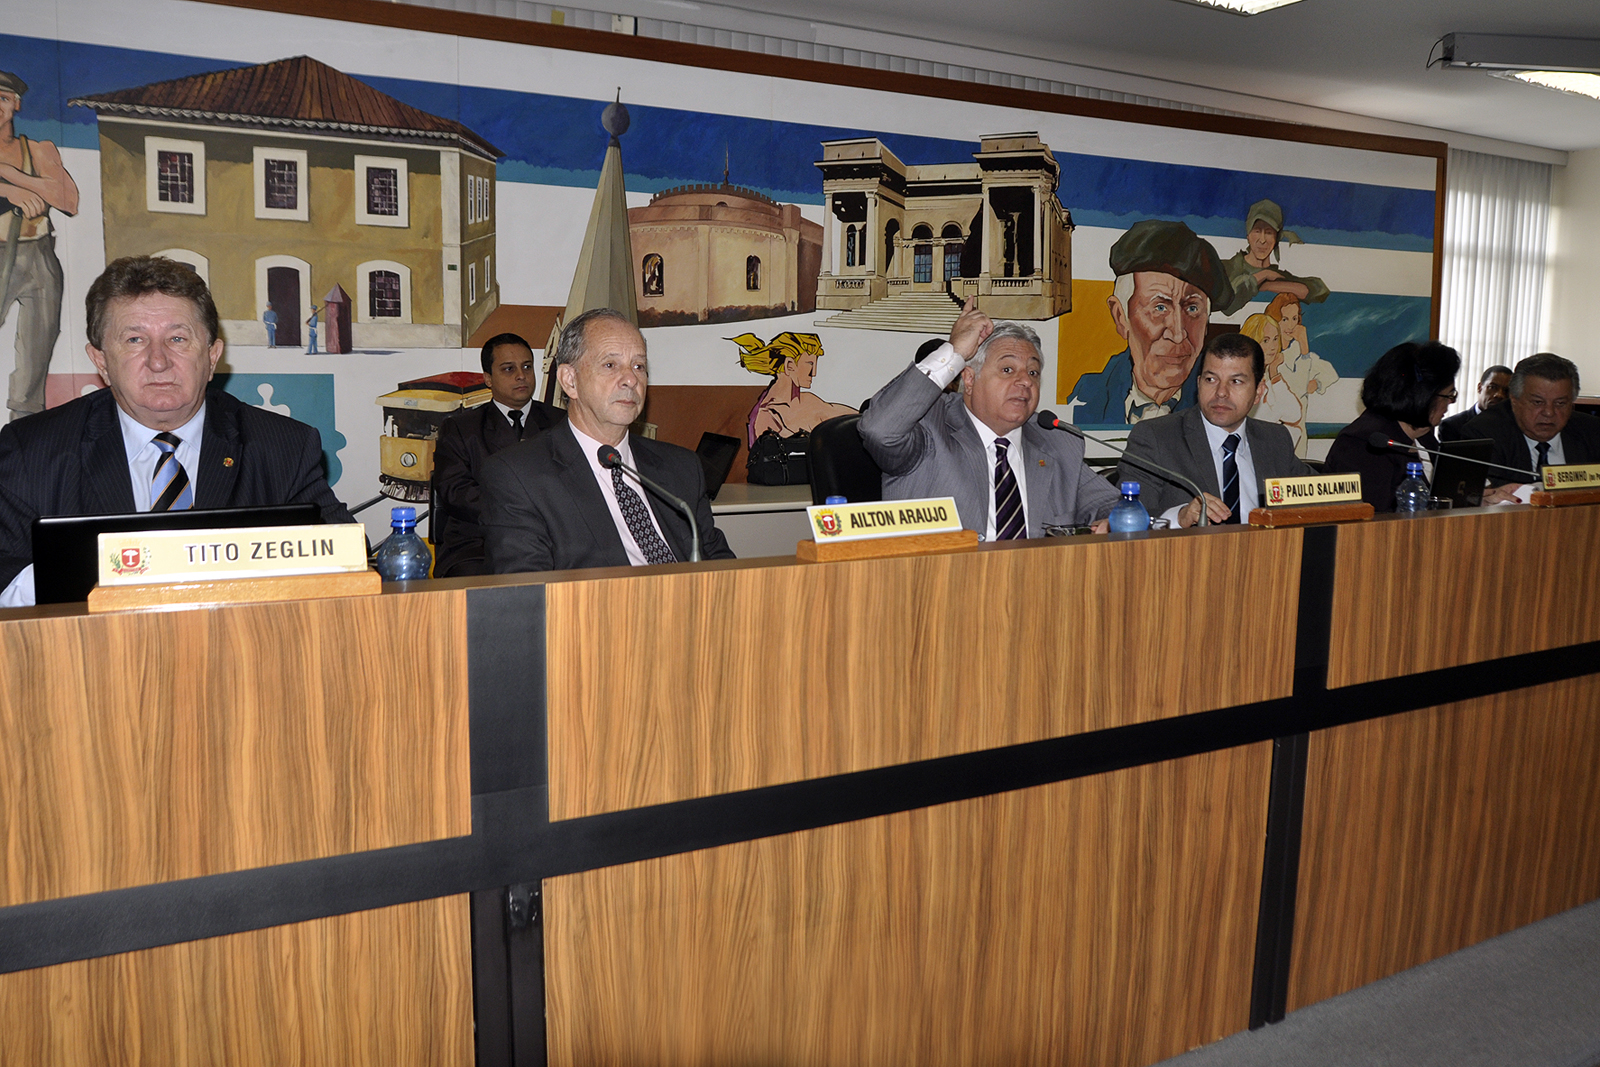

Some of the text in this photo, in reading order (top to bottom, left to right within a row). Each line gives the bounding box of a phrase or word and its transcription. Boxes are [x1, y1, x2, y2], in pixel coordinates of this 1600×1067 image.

[1557, 471, 1587, 483] SERGINHO
[1286, 481, 1360, 498] PAULO SALAMUNI
[850, 506, 947, 528] AILTON ARAUJO
[186, 539, 334, 562] TITO ZEGLIN
